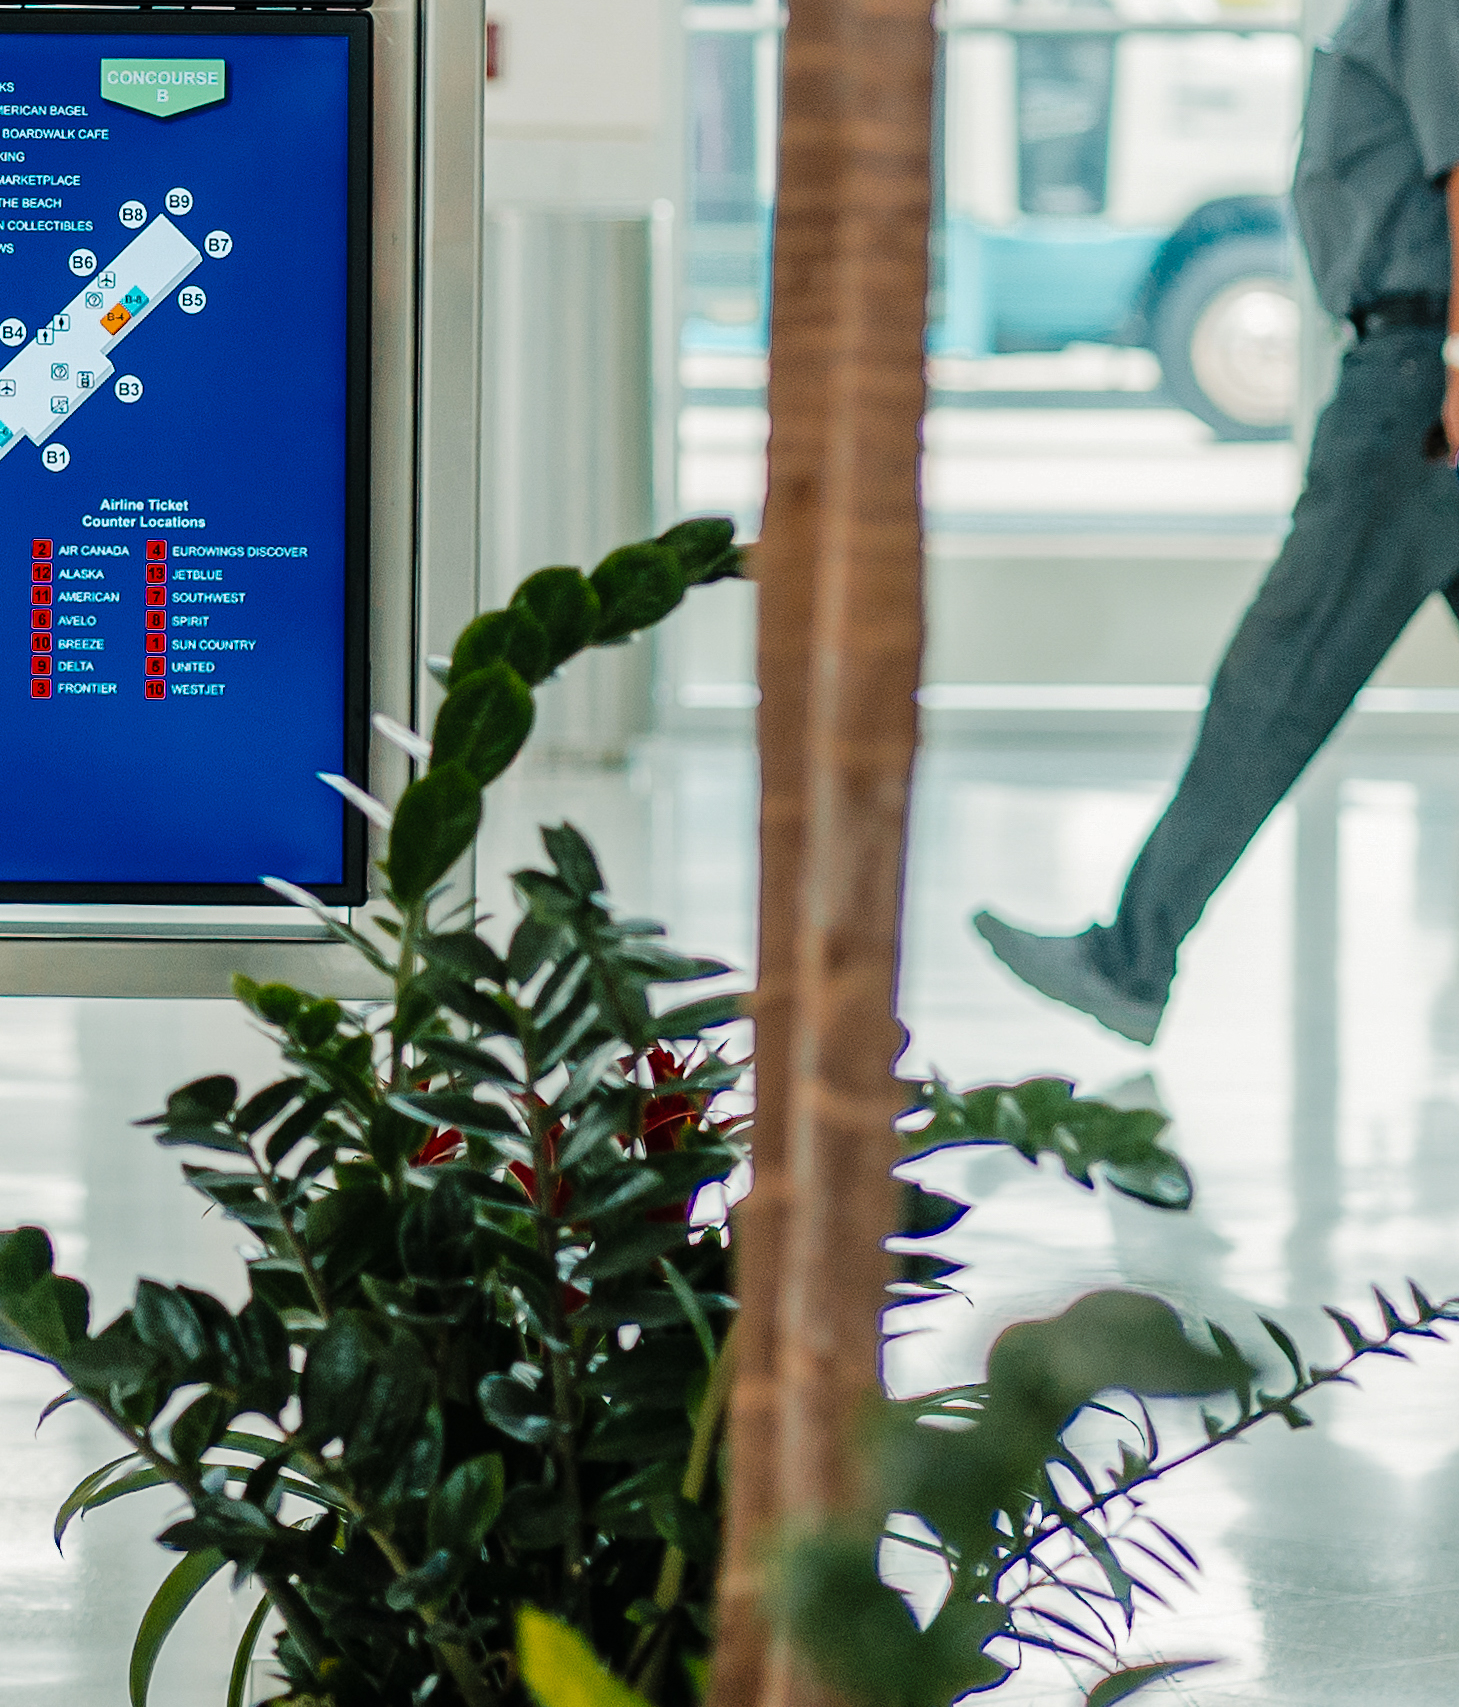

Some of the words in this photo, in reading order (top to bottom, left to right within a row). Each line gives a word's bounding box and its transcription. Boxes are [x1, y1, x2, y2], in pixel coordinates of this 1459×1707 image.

[107, 70, 219, 85] CONCOURSE
[49, 105, 89, 116] BAGEL
[2, 128, 76, 140] BOARDWALK
[78, 128, 108, 140] CAFE
[22, 197, 62, 209] BEACH
[169, 195, 190, 208] B9
[123, 208, 143, 221] B8
[7, 220, 94, 231] COLLECTIBLES
[209, 238, 229, 252] B7
[73, 256, 93, 269] B6
[183, 293, 203, 306] B5
[3, 326, 24, 339] B4
[119, 383, 139, 396] B3
[47, 451, 65, 464] B1
[100, 499, 145, 511] Airline
[148, 499, 189, 512] Ticket
[82, 515, 136, 528] Counter
[140, 516, 206, 528] Locations
[58, 545, 79, 556] AIR
[80, 545, 130, 556] CANADA
[172, 545, 245, 557] EUROWINGS
[248, 546, 308, 558] DISCOVER
[59, 569, 105, 580] ALASKA
[59, 591, 120, 603] AMERICAN
[172, 592, 246, 603] SOUTHWEST
[172, 615, 210, 626] SPIRIT
[171, 662, 216, 673] UNITED
